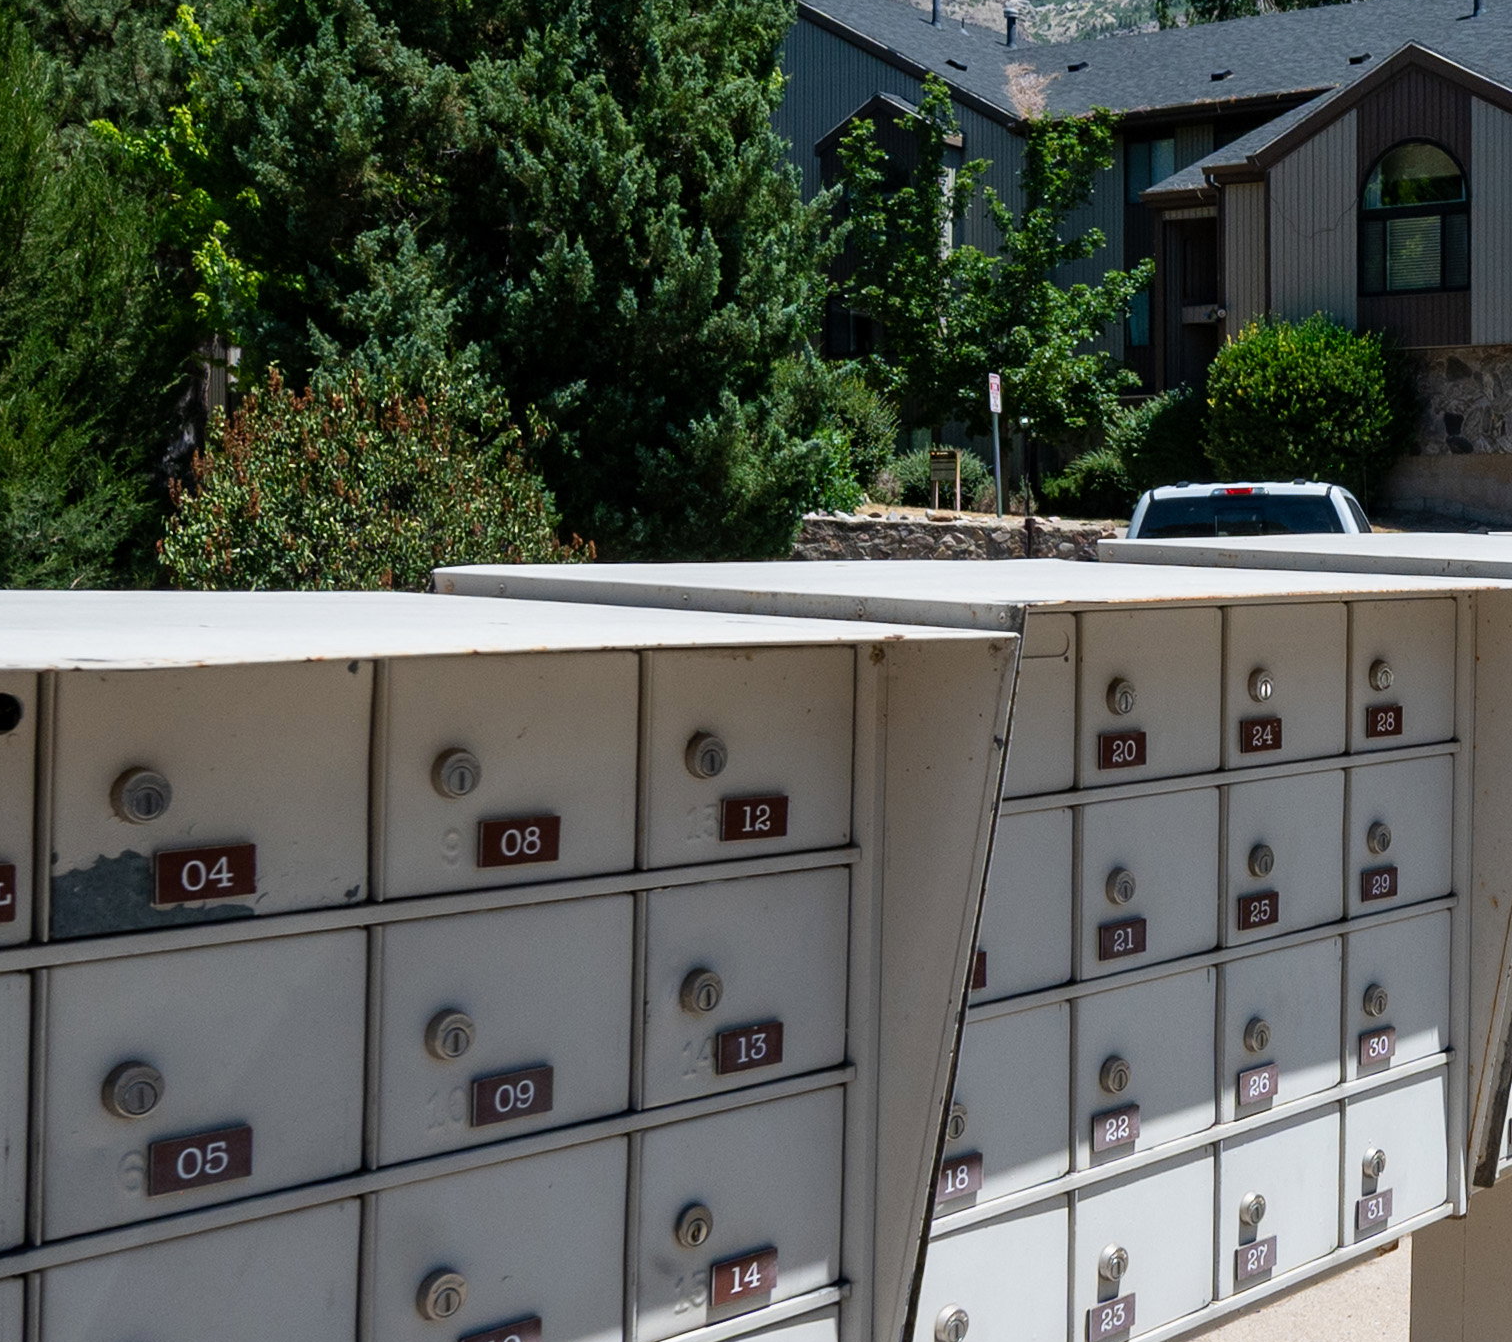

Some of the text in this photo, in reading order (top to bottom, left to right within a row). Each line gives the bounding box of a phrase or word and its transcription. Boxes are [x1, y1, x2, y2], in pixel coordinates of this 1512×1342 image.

[1377, 712, 1395, 732] 28
[1253, 725, 1273, 747] 24
[1113, 739, 1137, 763] 20
[742, 804, 771, 832] 12
[500, 826, 541, 857] 08
[180, 857, 234, 892] 04
[1372, 873, 1390, 895] 29
[1250, 899, 1271, 923] 25
[1113, 927, 1134, 953] 21
[737, 1035, 767, 1063] 13
[1368, 1035, 1389, 1057] 30
[1249, 1072, 1270, 1095] 26
[494, 1080, 535, 1115] 09
[1105, 1115, 1130, 1143] 22
[176, 1142, 229, 1180] 05
[944, 1165, 970, 1194] 18
[1367, 1197, 1385, 1220] 31
[1248, 1244, 1268, 1270] 27
[731, 1261, 761, 1294] 14
[1100, 1308, 1126, 1334] 23
